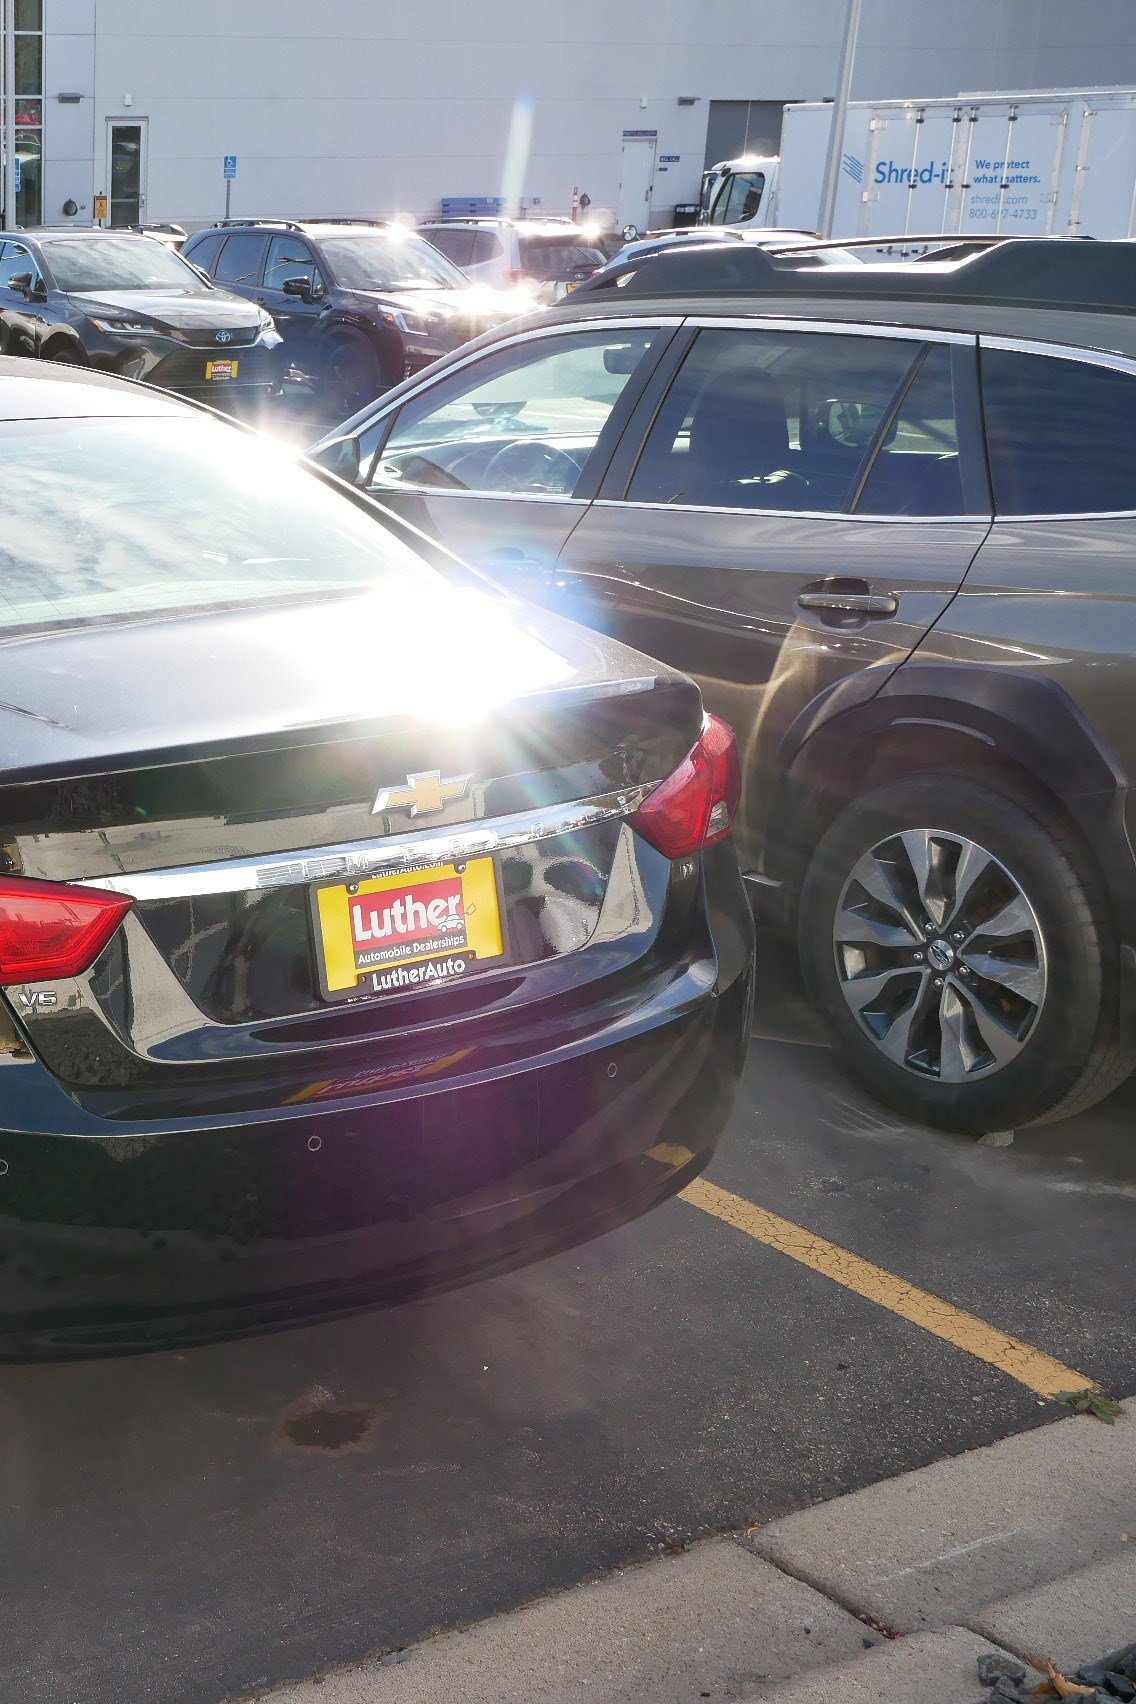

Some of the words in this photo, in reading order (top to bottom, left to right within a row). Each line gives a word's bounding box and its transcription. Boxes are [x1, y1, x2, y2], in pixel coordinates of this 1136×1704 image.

[975, 160, 990, 169] We
[973, 174, 998, 183] what
[970, 194, 1028, 204] shredi.com
[353, 894, 461, 941] Luther
[358, 945, 412, 965] Automobile
[413, 935, 465, 952] Dealerships
[372, 958, 466, 991] LutherAuto
[18, 991, 57, 1006] V6
